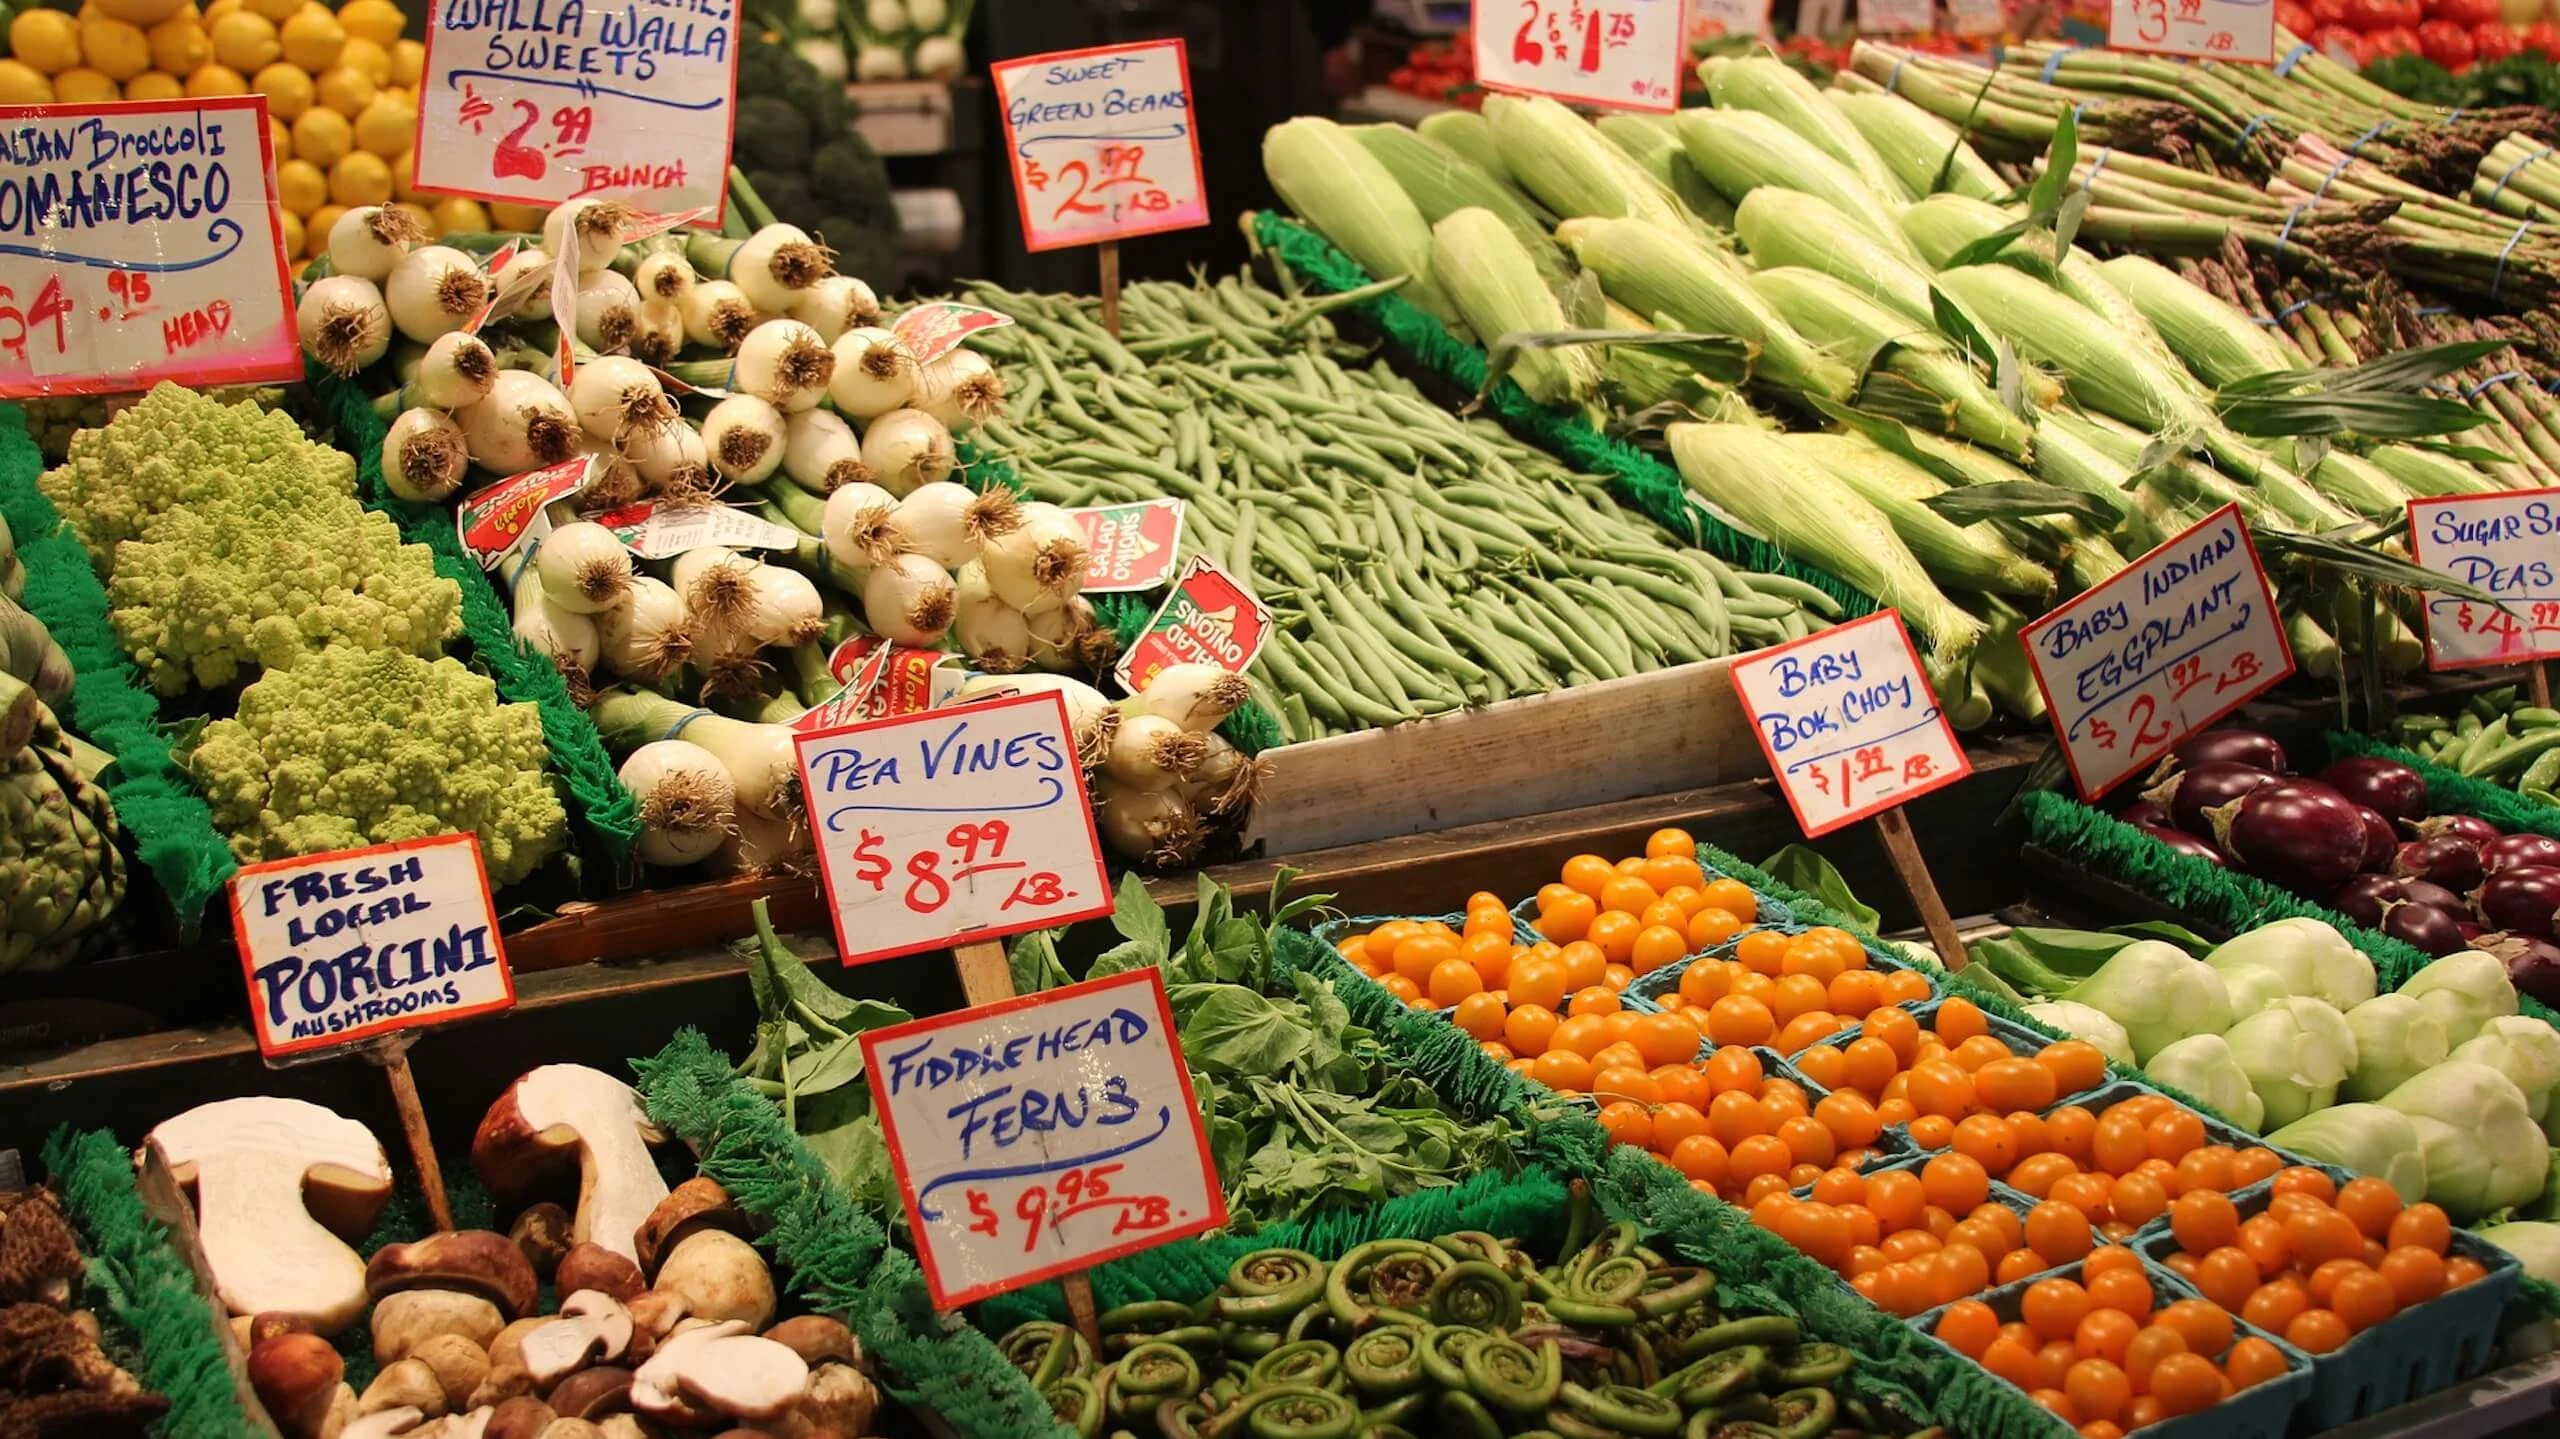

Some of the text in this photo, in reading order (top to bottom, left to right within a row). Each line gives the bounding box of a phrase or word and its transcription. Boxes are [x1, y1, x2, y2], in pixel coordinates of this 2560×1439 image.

[445, 0, 584, 38] WALLA
[600, 4, 728, 62] WALLA
[486, 34, 656, 80] SWEETS
[1045, 58, 1145, 86] SWEET
[1008, 88, 1189, 133] GREEN BEANS
[567, 159, 688, 200] BUNCH
[162, 299, 232, 355] HEAD
[1090, 519, 1118, 578] SALAD
[1111, 512, 1141, 581] ONIONS
[2431, 510, 2523, 547] SUGAR
[2040, 527, 2237, 659] BABY INDIAN
[2448, 555, 2554, 593] PEAS
[1174, 600, 1243, 663] ONIONS
[2076, 571, 2242, 703] EGGPLANT
[1769, 650, 1863, 698] BABY
[1757, 675, 1912, 752] BOK CHOY
[810, 722, 1064, 792] PEA VINES
[262, 856, 424, 917] FRESH
[1000, 872, 1079, 911] LB.
[288, 892, 432, 947] LOCAL
[253, 923, 497, 1027] PORCINI
[292, 980, 461, 1039] MUSHROOMS
[889, 1008, 1148, 1096] FIDDLEHEAD
